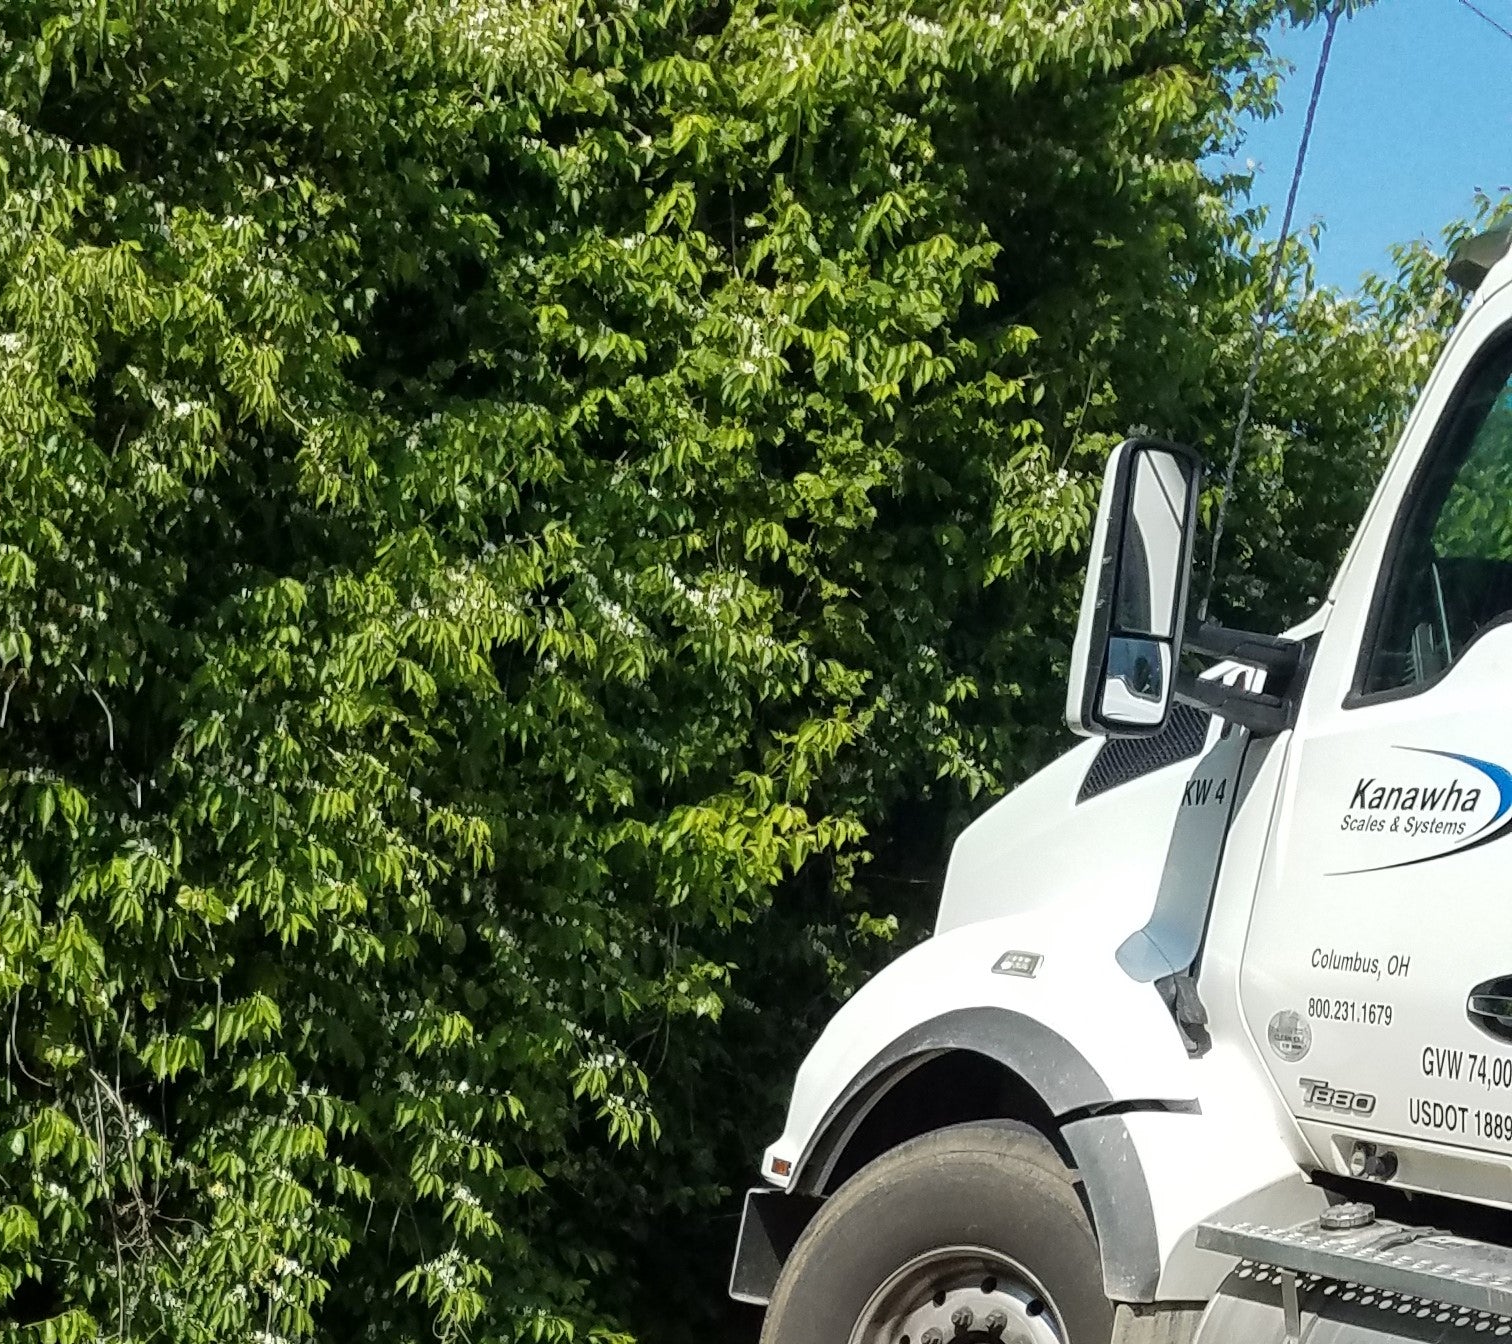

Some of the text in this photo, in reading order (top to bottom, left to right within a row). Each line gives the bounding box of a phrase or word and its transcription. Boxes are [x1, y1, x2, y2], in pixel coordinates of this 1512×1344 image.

[1180, 778, 1227, 807] KW 4
[1349, 778, 1482, 812] Kanawha
[1340, 814, 1467, 838] Scales & Systems
[1311, 948, 1411, 982] Columbus, OH
[1307, 997, 1393, 1026] 800.231.1679
[1422, 1046, 1464, 1081] GVW
[1299, 1077, 1377, 1117] T880
[1409, 1097, 1512, 1141] USDOT 1889
